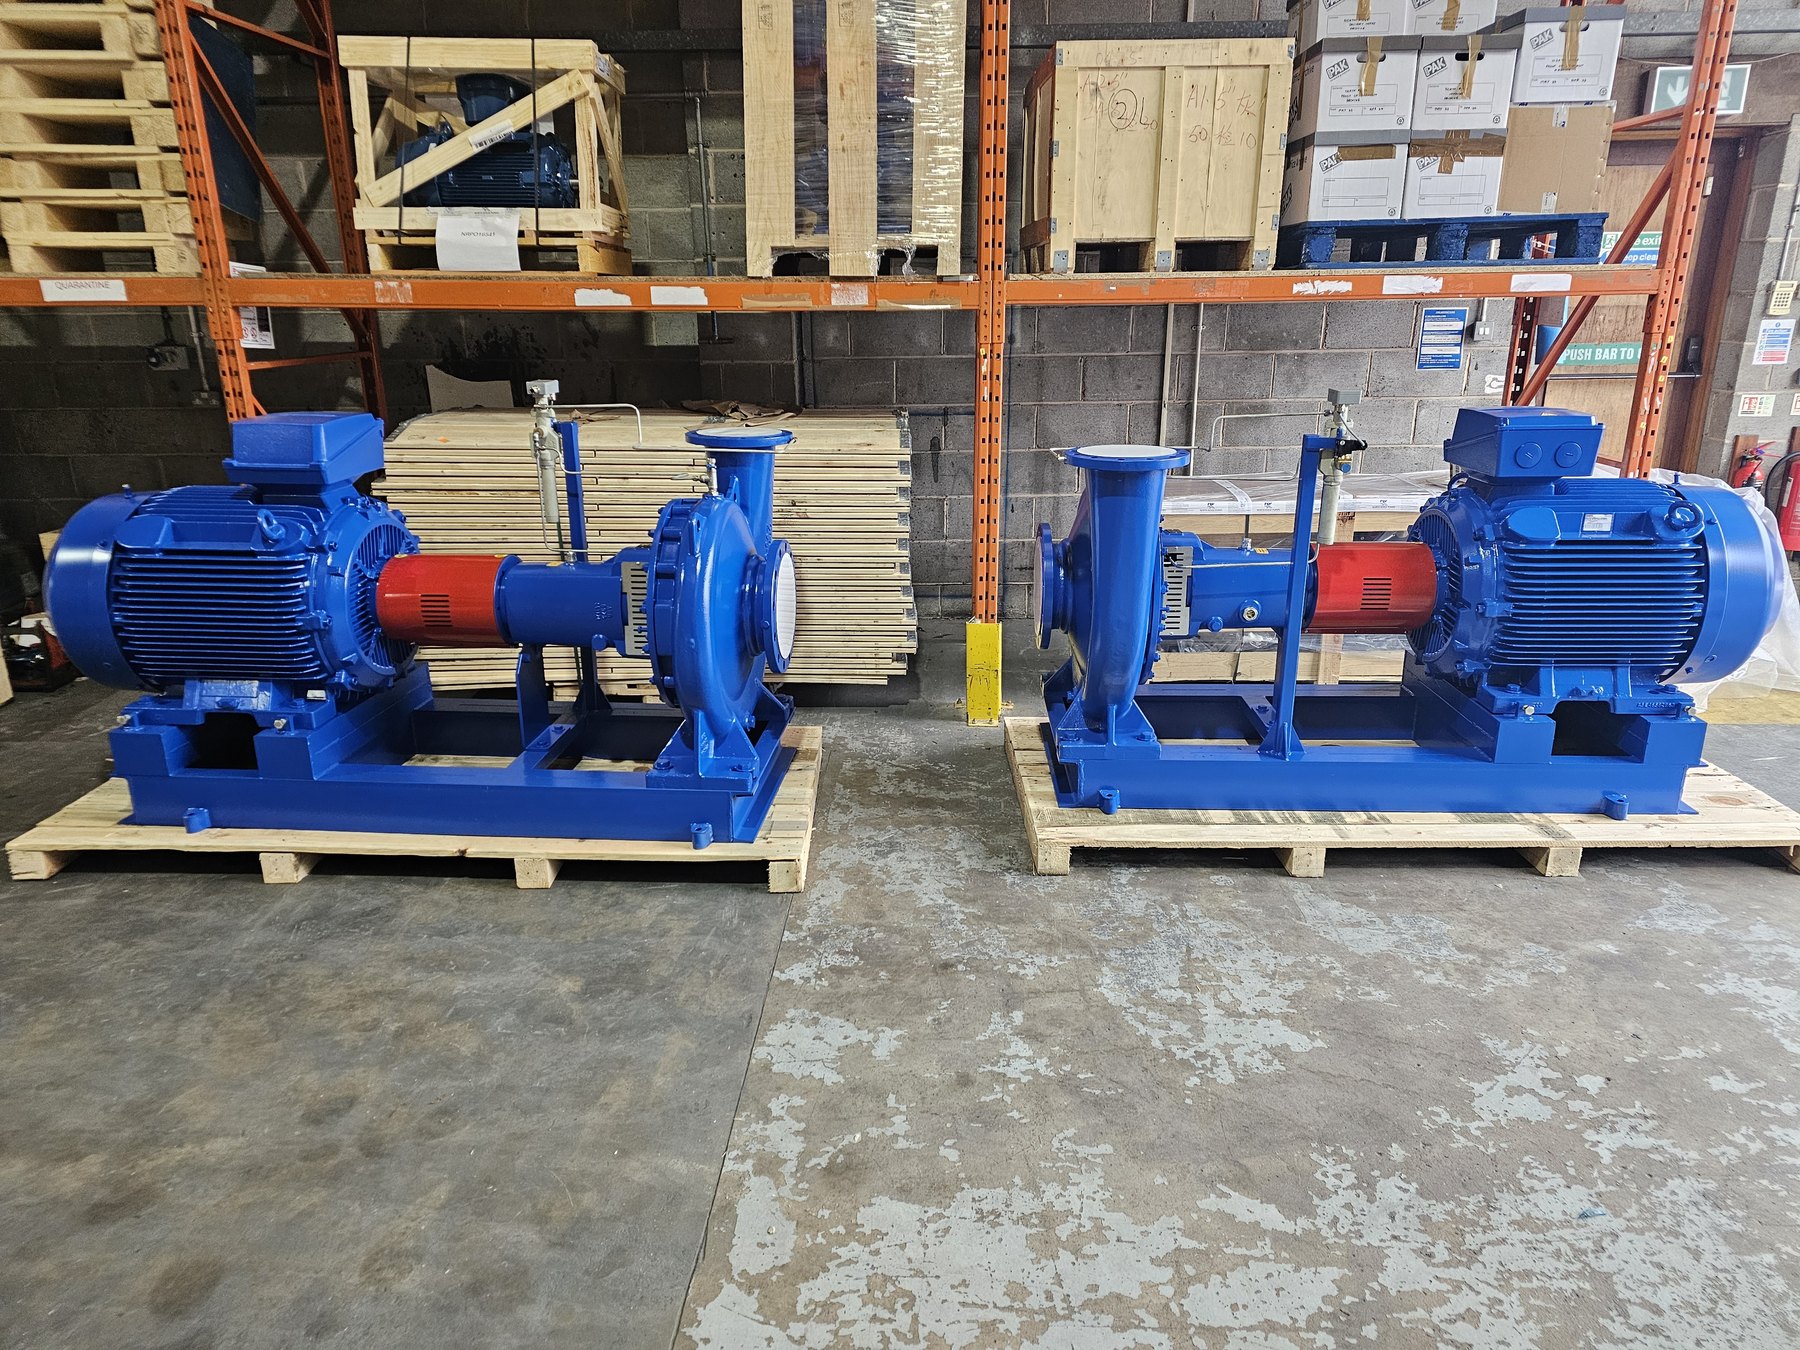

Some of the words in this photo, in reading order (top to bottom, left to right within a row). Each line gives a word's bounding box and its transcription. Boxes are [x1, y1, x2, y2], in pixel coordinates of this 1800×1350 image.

[1531, 29, 1553, 48] PAK
[1327, 59, 1349, 79] PAK
[1424, 57, 1446, 77] PAK
[54, 281, 111, 290] QUARANTINE
[1564, 348, 1592, 360] PUSH
[1595, 348, 1617, 360] BAR
[1620, 347, 1634, 359] TO
